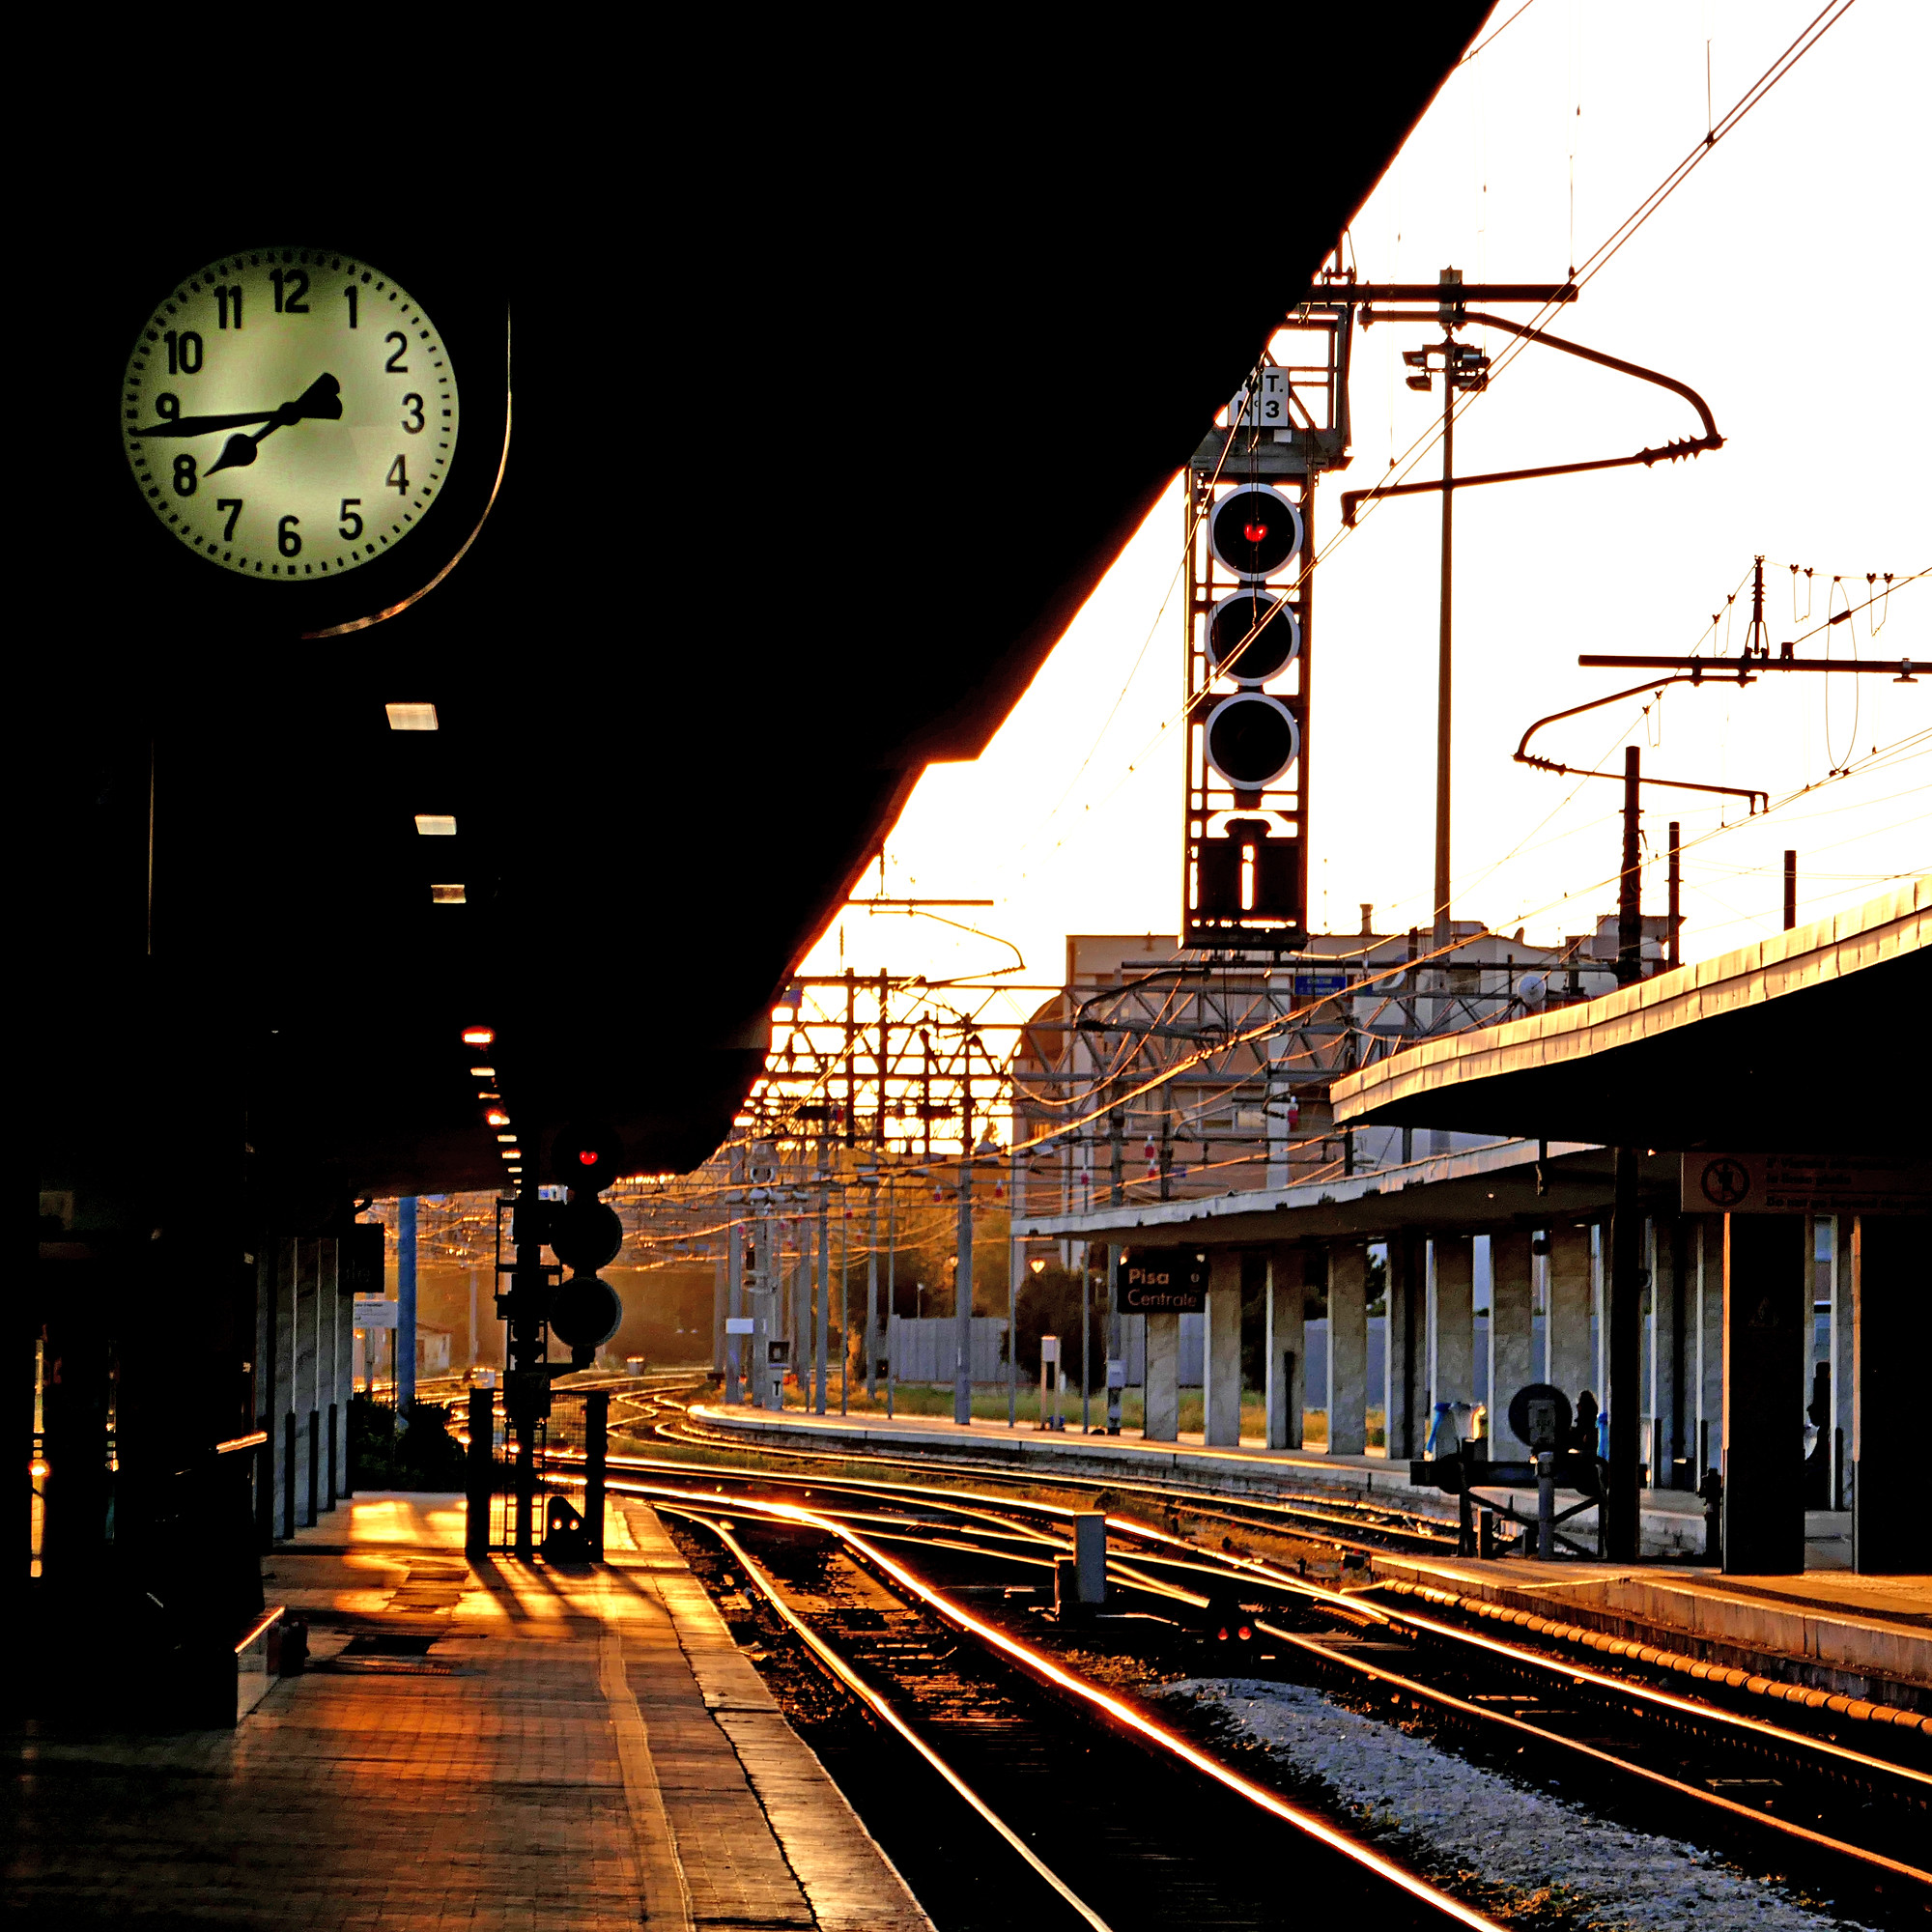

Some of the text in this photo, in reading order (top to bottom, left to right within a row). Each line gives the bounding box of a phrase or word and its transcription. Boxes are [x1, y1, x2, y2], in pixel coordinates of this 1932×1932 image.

[213, 285, 242, 329] 11
[269, 268, 310, 313] 12
[344, 285, 357, 329] 1
[163, 330, 204, 375] 10
[384, 330, 409, 373] 2
[155, 392, 180, 423] 9
[401, 392, 425, 435] 3
[1265, 400, 1280, 419] 3
[172, 454, 197, 497] 8
[384, 454, 410, 497] 4
[216, 498, 243, 542] 7
[277, 515, 302, 558] 6
[338, 498, 363, 541] 5
[1128, 1267, 1170, 1285] Pisa
[1127, 1289, 1197, 1307] Centrale
